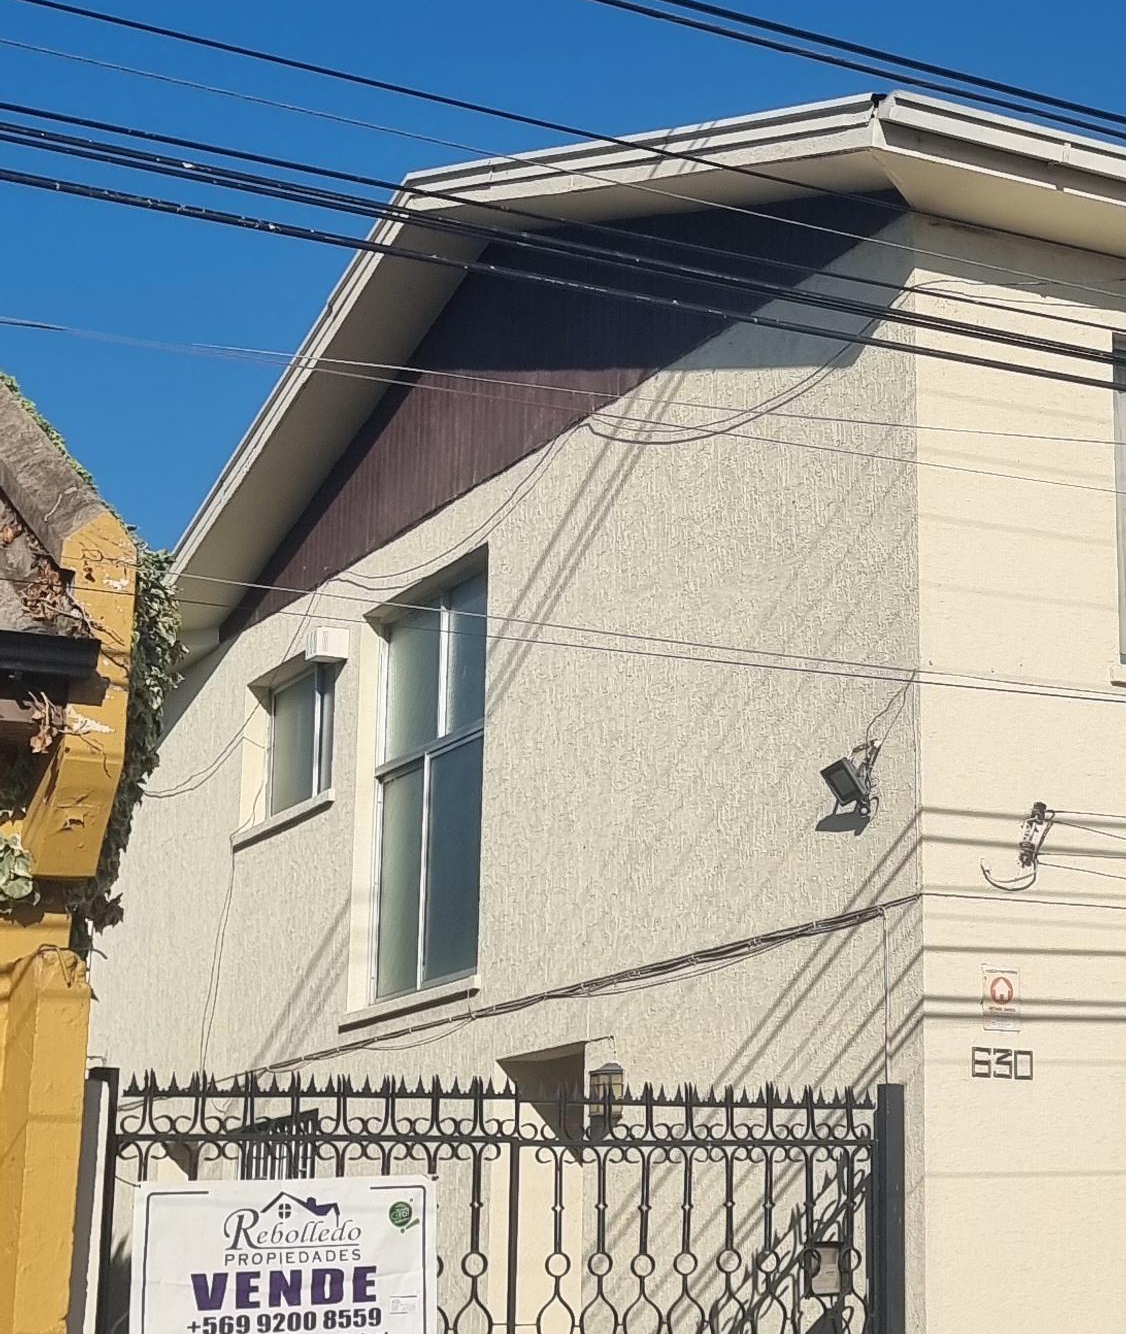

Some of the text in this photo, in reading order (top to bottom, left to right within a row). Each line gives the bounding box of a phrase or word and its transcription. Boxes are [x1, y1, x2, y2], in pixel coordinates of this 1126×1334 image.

[971, 1046, 1034, 1080] 630
[224, 1209, 361, 1250] Rebolledo
[224, 1249, 361, 1266] PROPIEDADES
[190, 1265, 377, 1311] VENDE
[256, 1312, 317, 1333] 9200
[322, 1307, 382, 1329] 8559
